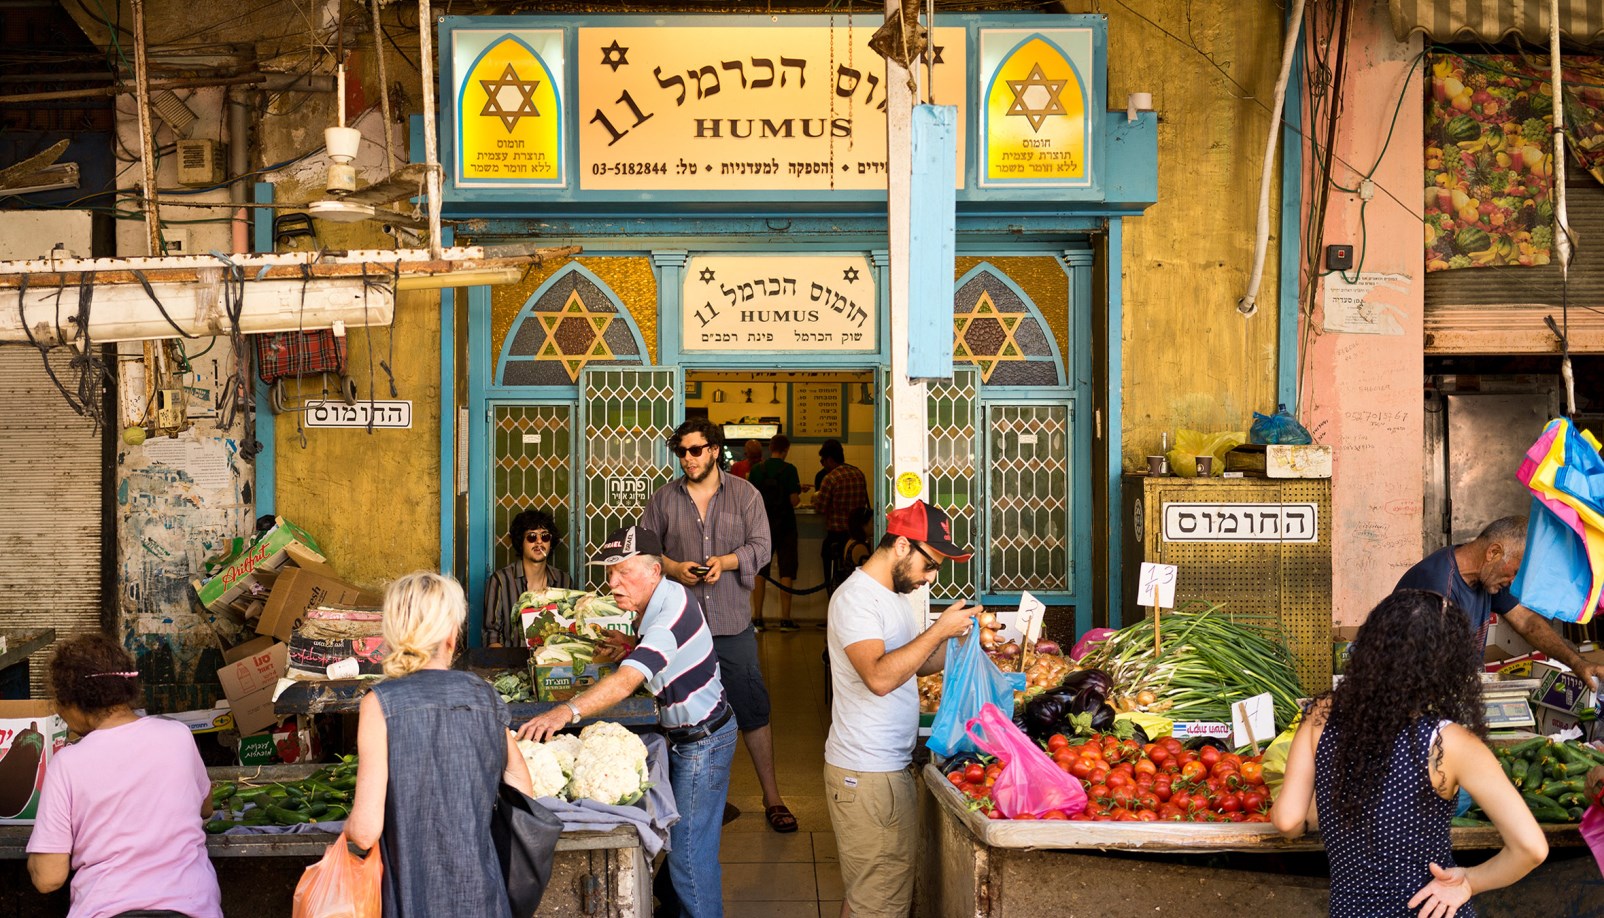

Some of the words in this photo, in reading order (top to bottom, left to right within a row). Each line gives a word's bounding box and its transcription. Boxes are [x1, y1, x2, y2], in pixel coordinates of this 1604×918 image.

[653, 55, 808, 107] הכרמל
[589, 88, 654, 147] 11
[694, 118, 852, 138] HUMUS
[497, 139, 525, 149] חומוס
[1022, 138, 1051, 149] חומוס
[476, 152, 509, 162] עצמית
[513, 152, 545, 161] תוצרת
[1002, 151, 1034, 162] עצמית
[1039, 151, 1071, 161] תוצרת
[470, 163, 499, 173] משמר
[503, 163, 527, 173] חומר
[531, 161, 552, 173] ללא
[592, 162, 668, 175] 03-5182844
[676, 158, 698, 175] טל:
[721, 157, 779, 175] למעדניות
[788, 161, 834, 178] והספקה
[995, 163, 1025, 173] משמר
[1028, 163, 1053, 173] חומר
[1057, 160, 1078, 173] ללא
[719, 277, 797, 307] הכרמל
[810, 281, 868, 328] חומוס
[693, 301, 720, 328] 11
[740, 310, 820, 322] HUMUS
[747, 332, 774, 342] פינת
[794, 329, 833, 342] הכרמל
[841, 333, 863, 345] שוק
[315, 406, 402, 422] החומוס
[611, 480, 646, 492] פתוח
[1178, 511, 1305, 534] החומוס
[1162, 566, 1174, 585] 3
